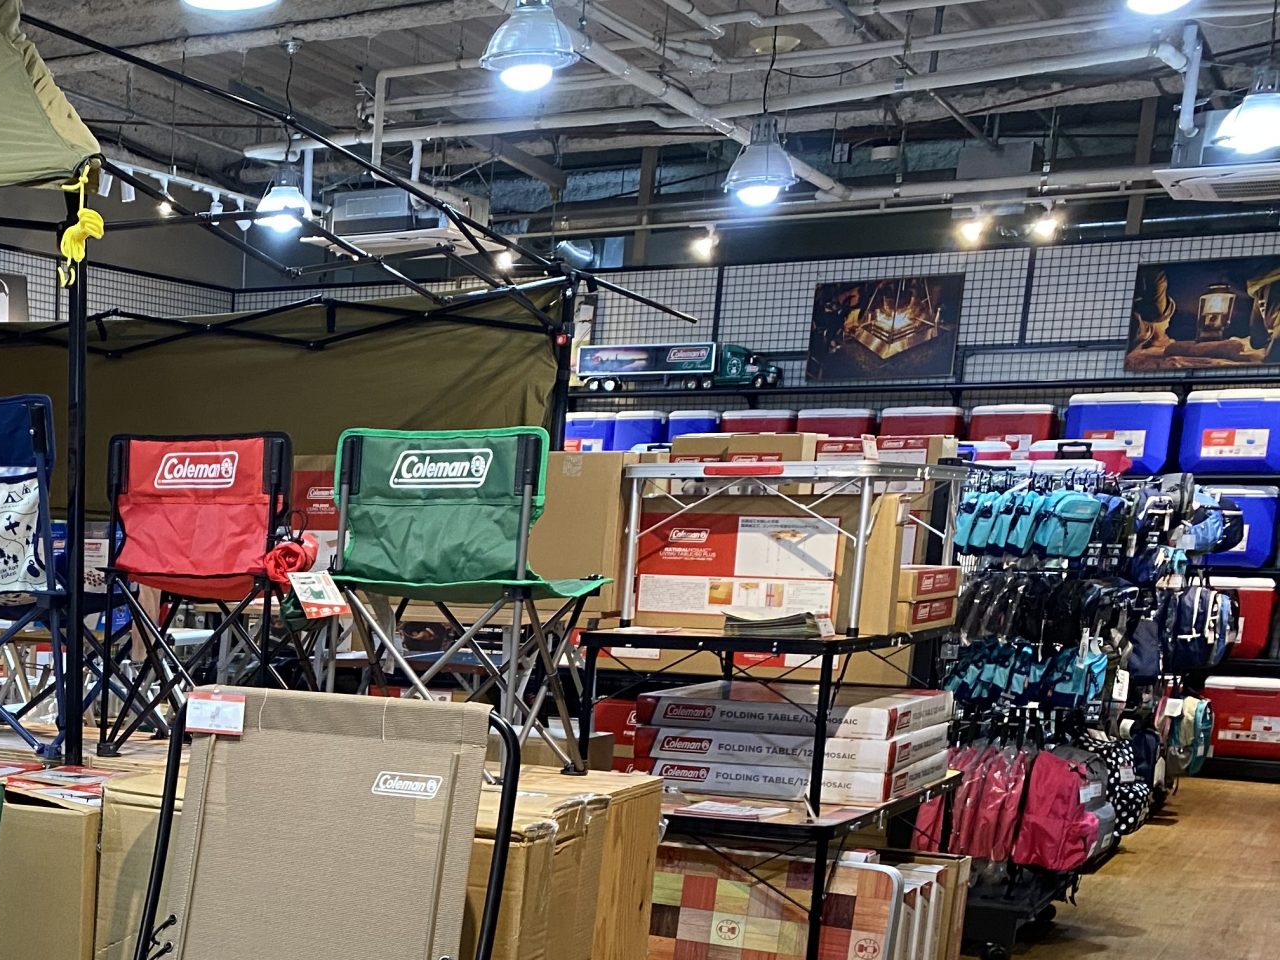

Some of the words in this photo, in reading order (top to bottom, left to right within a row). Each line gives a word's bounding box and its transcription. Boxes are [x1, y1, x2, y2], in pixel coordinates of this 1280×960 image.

[164, 457, 221, 479] Coleman
[400, 455, 471, 478] Coleman
[667, 705, 705, 716] Coleman
[720, 710, 766, 720] FOLDING
[767, 712, 816, 724] TABLE/12
[664, 737, 701, 750] Coleman
[718, 743, 763, 754] FOLDING
[766, 746, 815, 757] TABLE/12
[824, 752, 857, 760] MOSAIC
[662, 765, 699, 778] Coleman
[715, 771, 760, 783] FOLDING
[378, 774, 427, 792] Coleman
